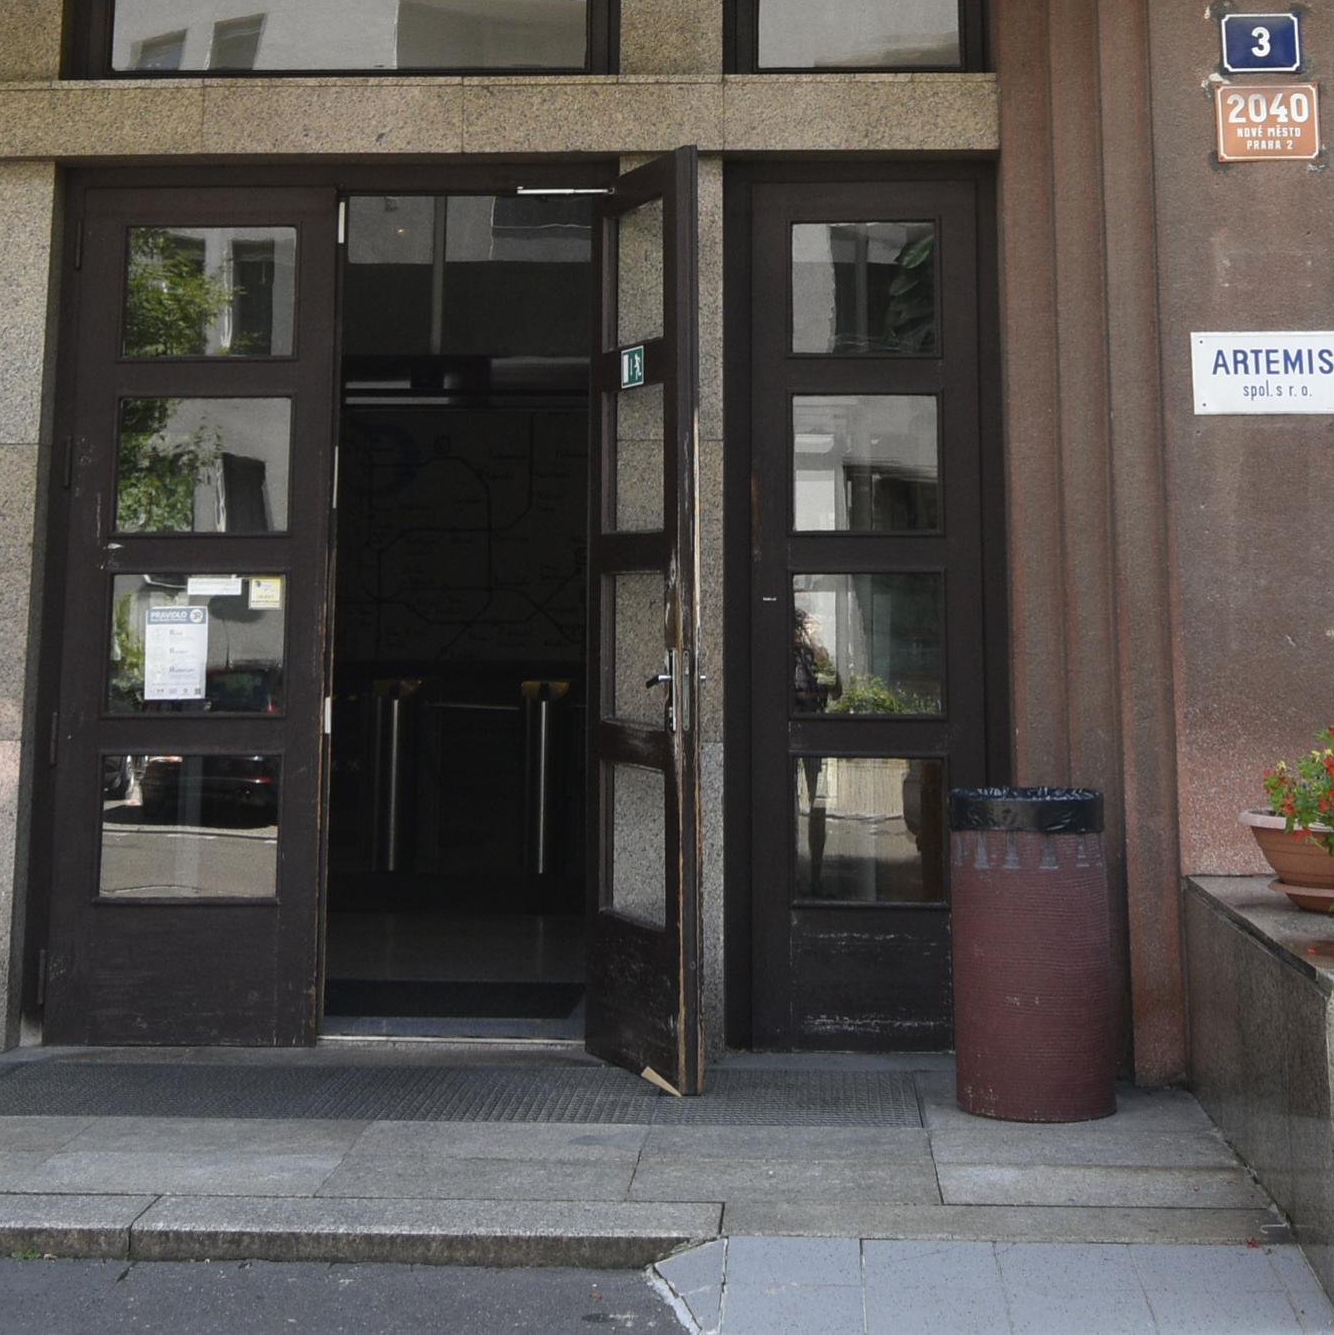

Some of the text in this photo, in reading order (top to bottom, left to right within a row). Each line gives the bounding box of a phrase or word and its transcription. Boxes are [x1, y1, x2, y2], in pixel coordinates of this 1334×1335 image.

[1251, 26, 1271, 58] 3
[1227, 93, 1309, 123] 2040
[1236, 125, 1301, 138] NOVÉ MĚSTO
[1246, 140, 1293, 150] PRAHA 2
[1212, 349, 1334, 375] ARTEMIS
